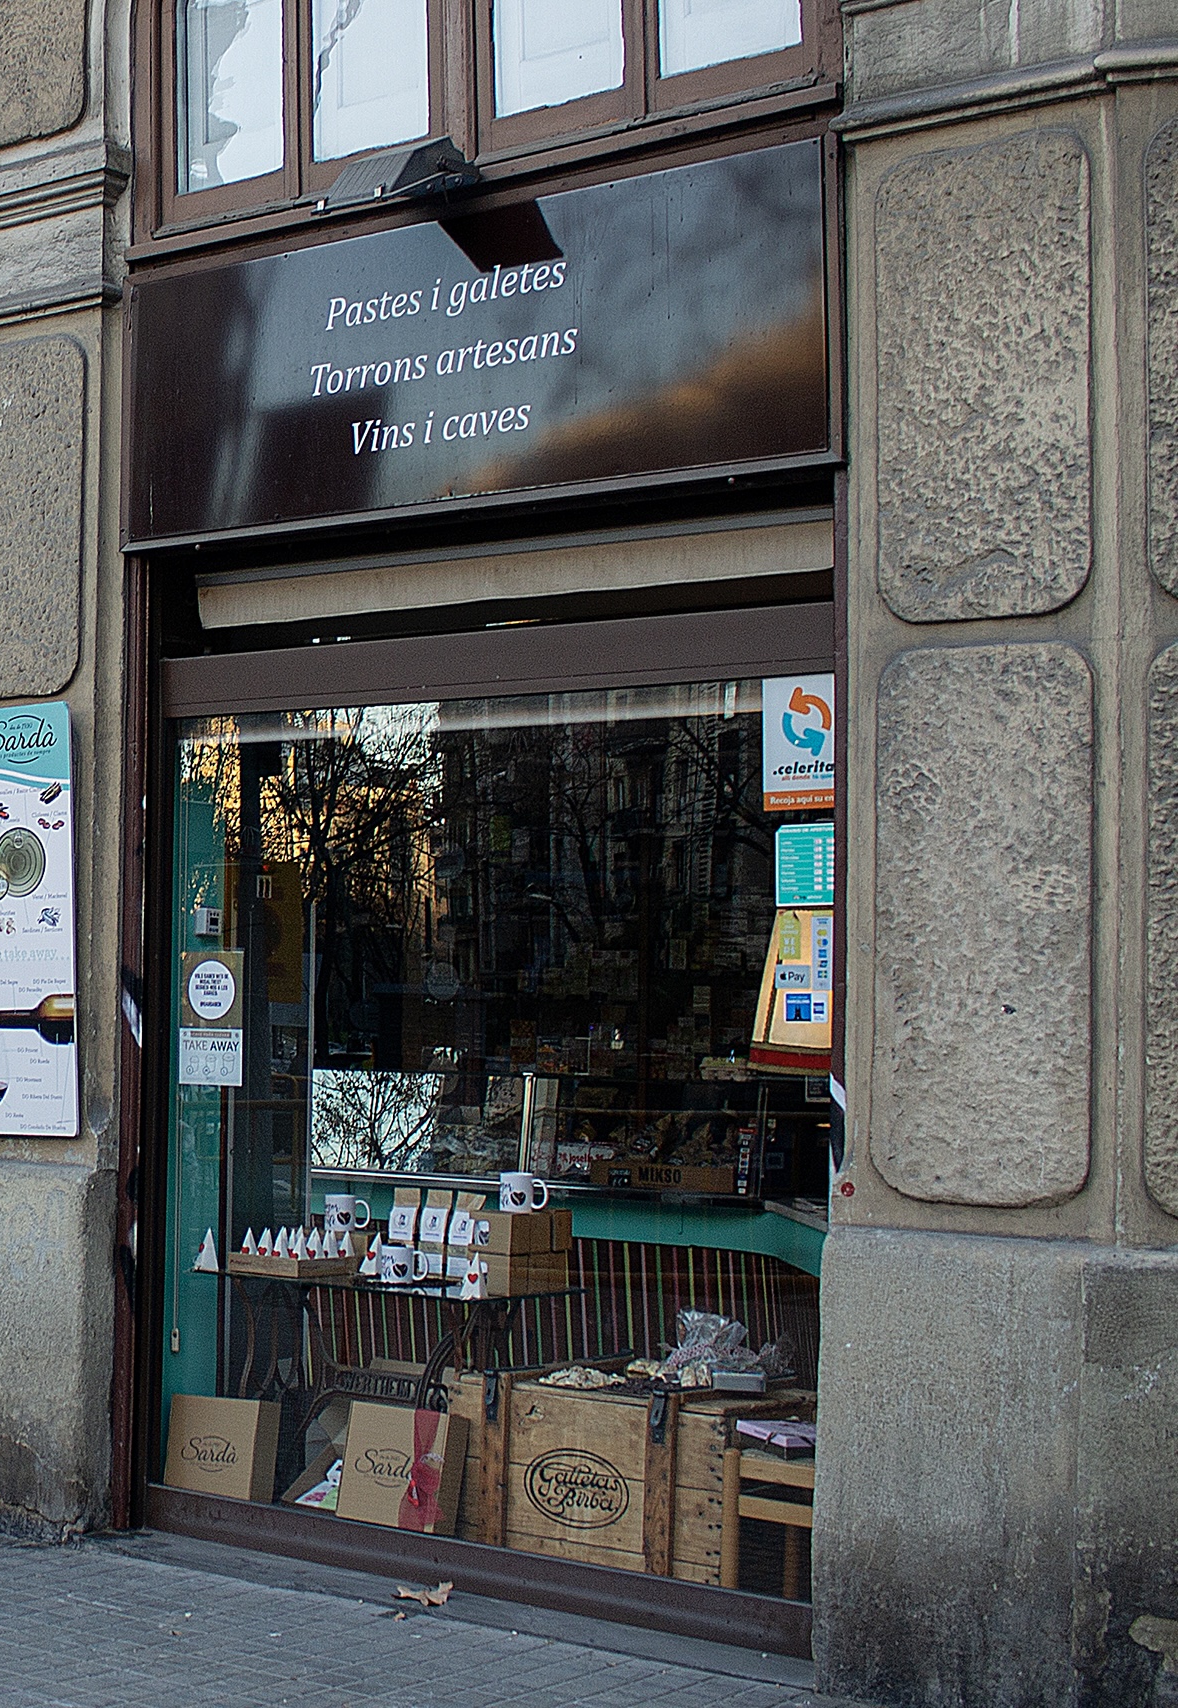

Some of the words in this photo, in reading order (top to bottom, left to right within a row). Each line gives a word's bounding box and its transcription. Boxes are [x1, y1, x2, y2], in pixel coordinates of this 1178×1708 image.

[325, 290, 422, 330] Pastes
[431, 278, 441, 310] i
[446, 261, 566, 316] galetes
[310, 354, 427, 397] Torrons
[436, 328, 578, 375] artesans
[352, 419, 415, 454] Vins
[424, 411, 434, 443] i
[442, 404, 531, 441] caves
[770, 796, 794, 805] Recoja
[796, 794, 813, 805] aquí
[4, 947, 27, 958] take
[788, 972, 805, 983] Pay
[183, 1040, 207, 1050] TAKE
[210, 1041, 239, 1051] AWAY
[638, 1167, 682, 1183] MIKSO
[181, 1436, 238, 1463] Sardà
[538, 1463, 619, 1496] Galletas
[546, 1484, 619, 1514] Birba
